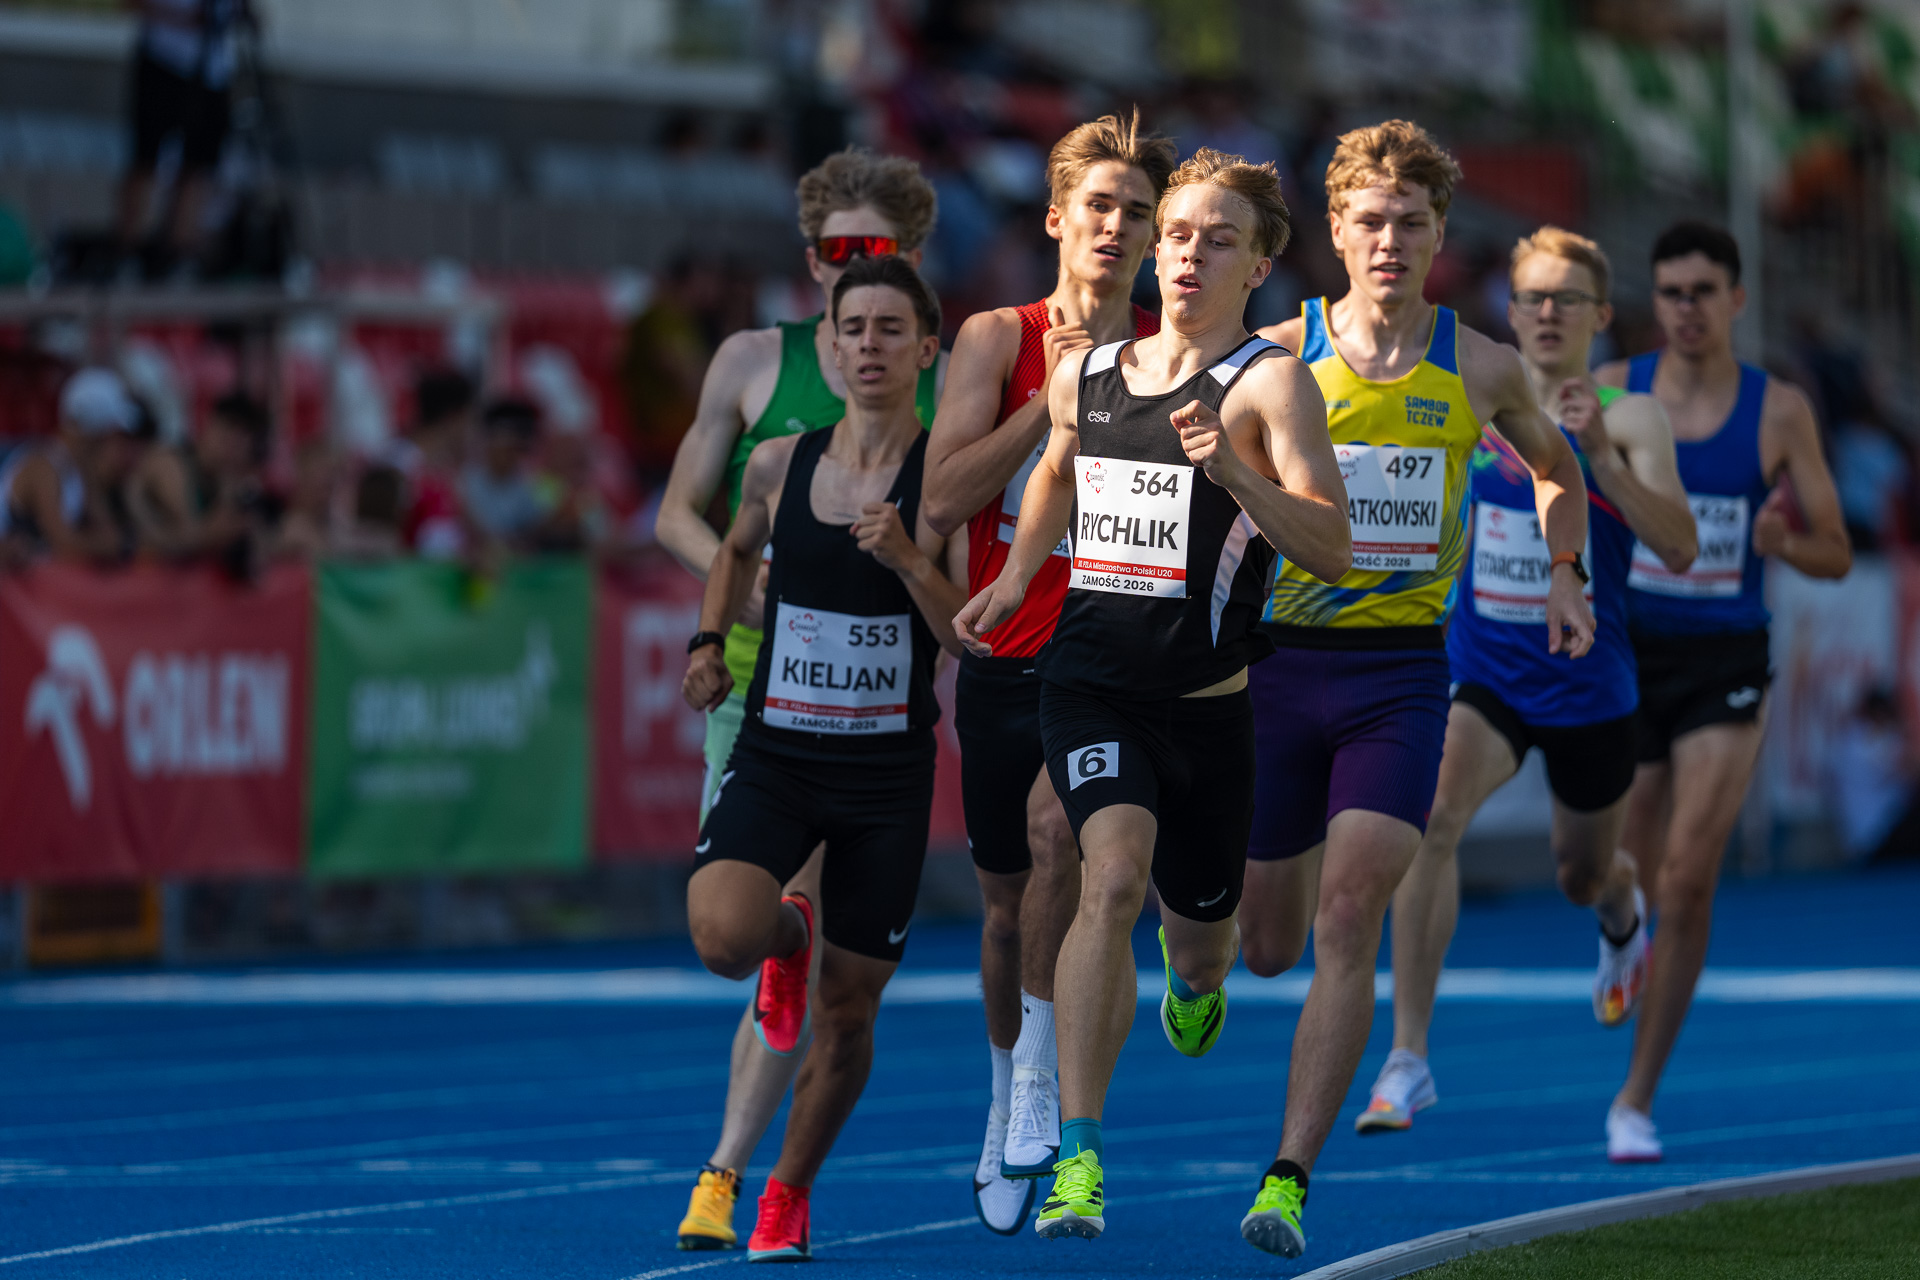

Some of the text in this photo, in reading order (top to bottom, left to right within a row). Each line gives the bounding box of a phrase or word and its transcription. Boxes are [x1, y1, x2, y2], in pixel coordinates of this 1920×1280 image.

[1404, 395, 1450, 415] SAMBOR
[1406, 409, 1447, 428] TCZEW
[1385, 455, 1433, 479] 497
[1130, 470, 1178, 498] 564
[1080, 512, 1179, 550] RYCHLIK
[1093, 562, 1131, 574] Mistrzostwa
[1132, 566, 1156, 576] Polski
[1157, 569, 1173, 578] U20
[1384, 556, 1411, 567] 2026
[1082, 575, 1154, 592] ZAMOŚĆ 2026
[847, 624, 898, 647] 553
[782, 656, 896, 691] KIELJAN
[791, 715, 878, 731] ZAMOŚĆ 2026
[1078, 747, 1106, 778] 6
